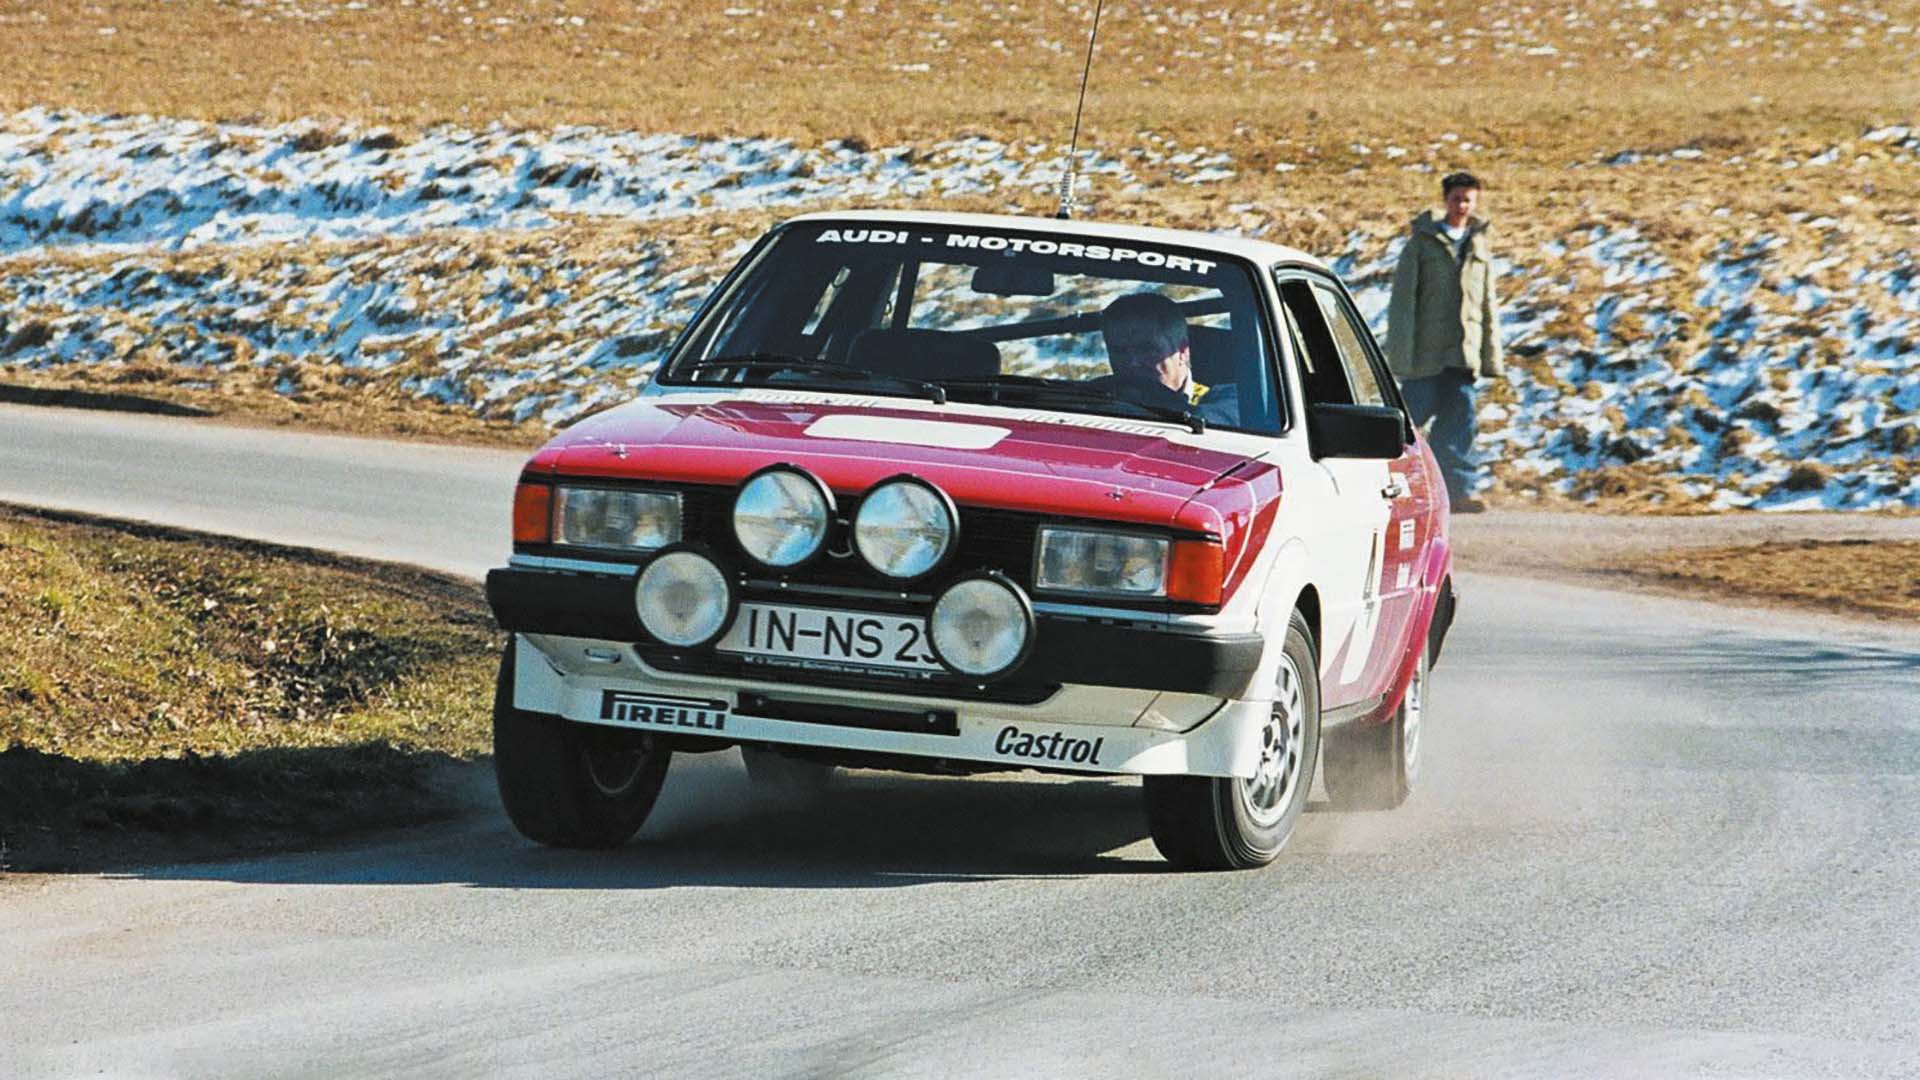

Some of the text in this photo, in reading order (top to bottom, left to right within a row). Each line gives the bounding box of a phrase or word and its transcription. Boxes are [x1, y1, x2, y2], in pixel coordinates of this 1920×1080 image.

[815, 229, 909, 244] AUDI
[945, 233, 1217, 275] MOTORSPORT
[747, 608, 885, 659] IN-NS
[600, 688, 729, 731] PIRELLI
[995, 725, 1104, 765] Castrol
